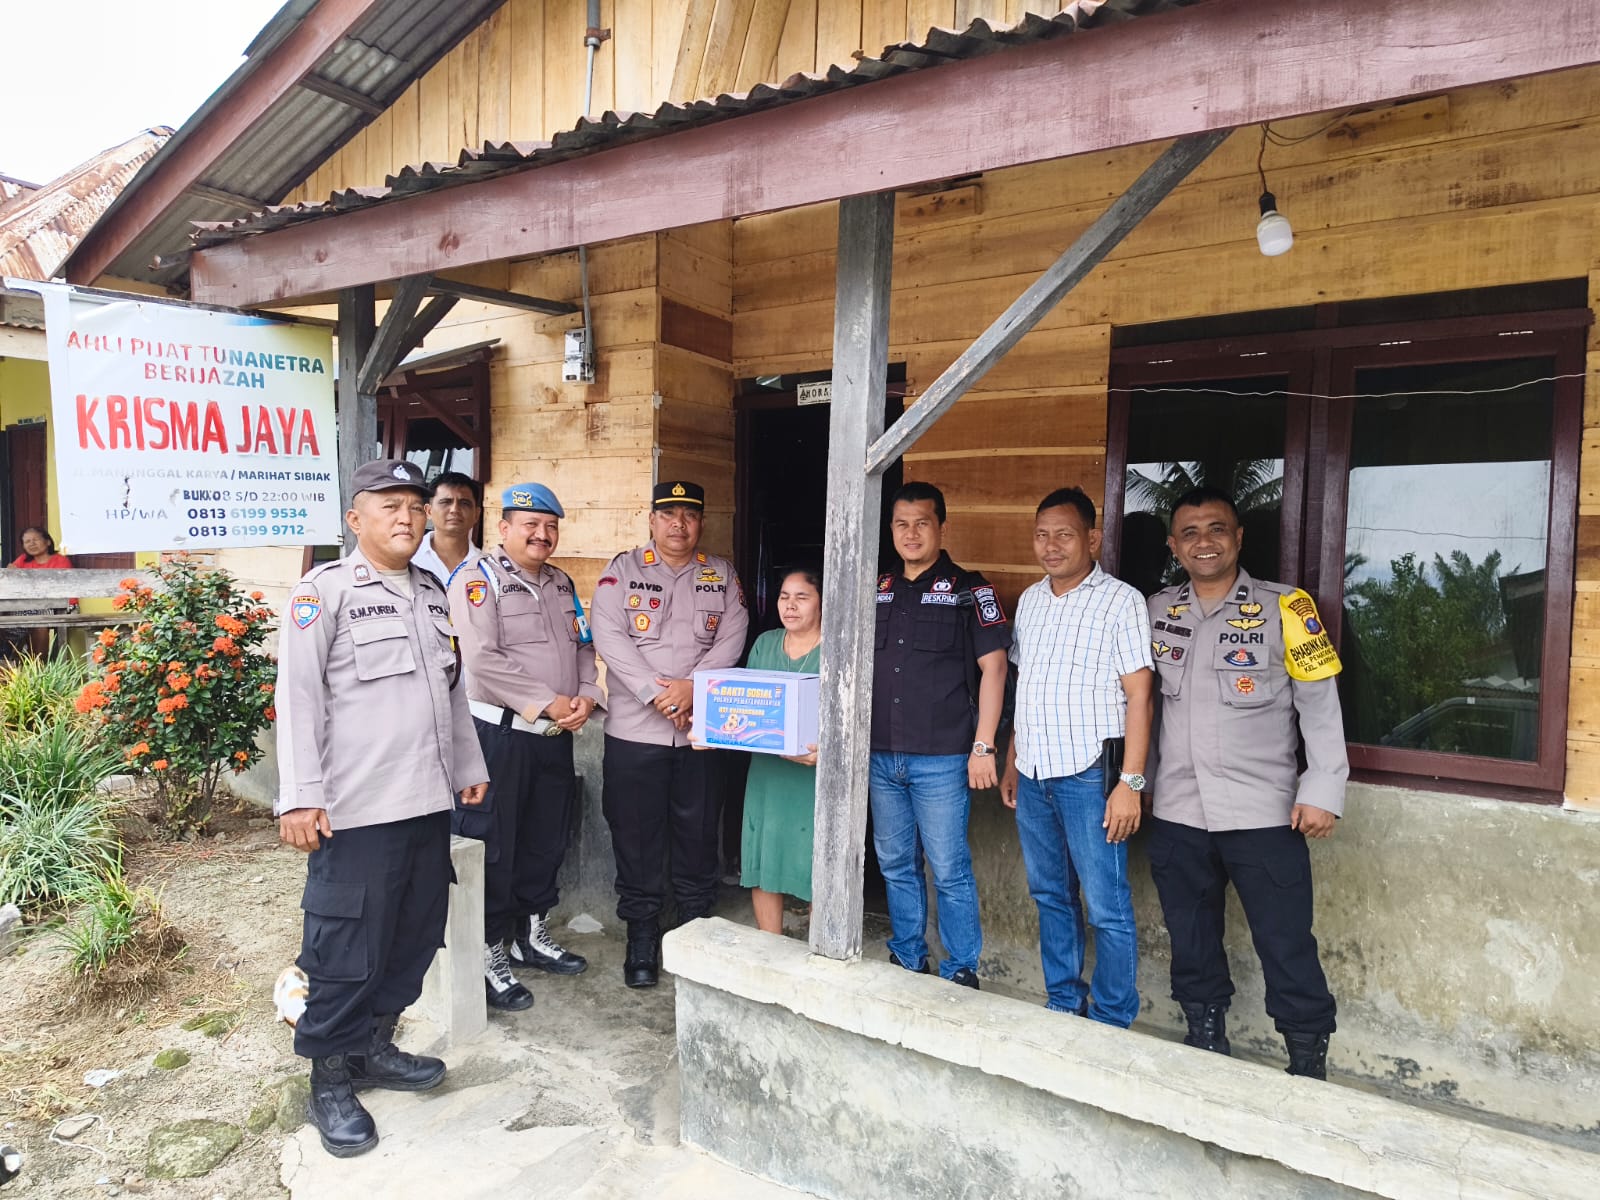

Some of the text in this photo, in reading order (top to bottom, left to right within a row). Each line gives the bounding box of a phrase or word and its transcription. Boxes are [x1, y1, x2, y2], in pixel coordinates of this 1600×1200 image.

[67, 330, 325, 374] AHLI PIJAT TUNANETRA
[144, 362, 265, 389] BERIJAZAH
[806, 386, 832, 399] HORA
[76, 394, 321, 456] KRISMA JAYA
[186, 469, 228, 480] KARYA
[238, 470, 292, 481] MARIHAT
[294, 472, 331, 482] SIBIAK
[235, 491, 259, 502] S/D
[262, 491, 298, 502] 22:00
[301, 492, 326, 502] WIB
[187, 508, 308, 519] 0813 6199 9534
[188, 525, 305, 537] 0813 6199 9712
[629, 581, 663, 592] DAVID
[923, 593, 956, 603] RESKRIM
[349, 605, 398, 619] S.M.PURBA
[1219, 632, 1264, 644] POLRI
[721, 687, 745, 697] BAKTI
